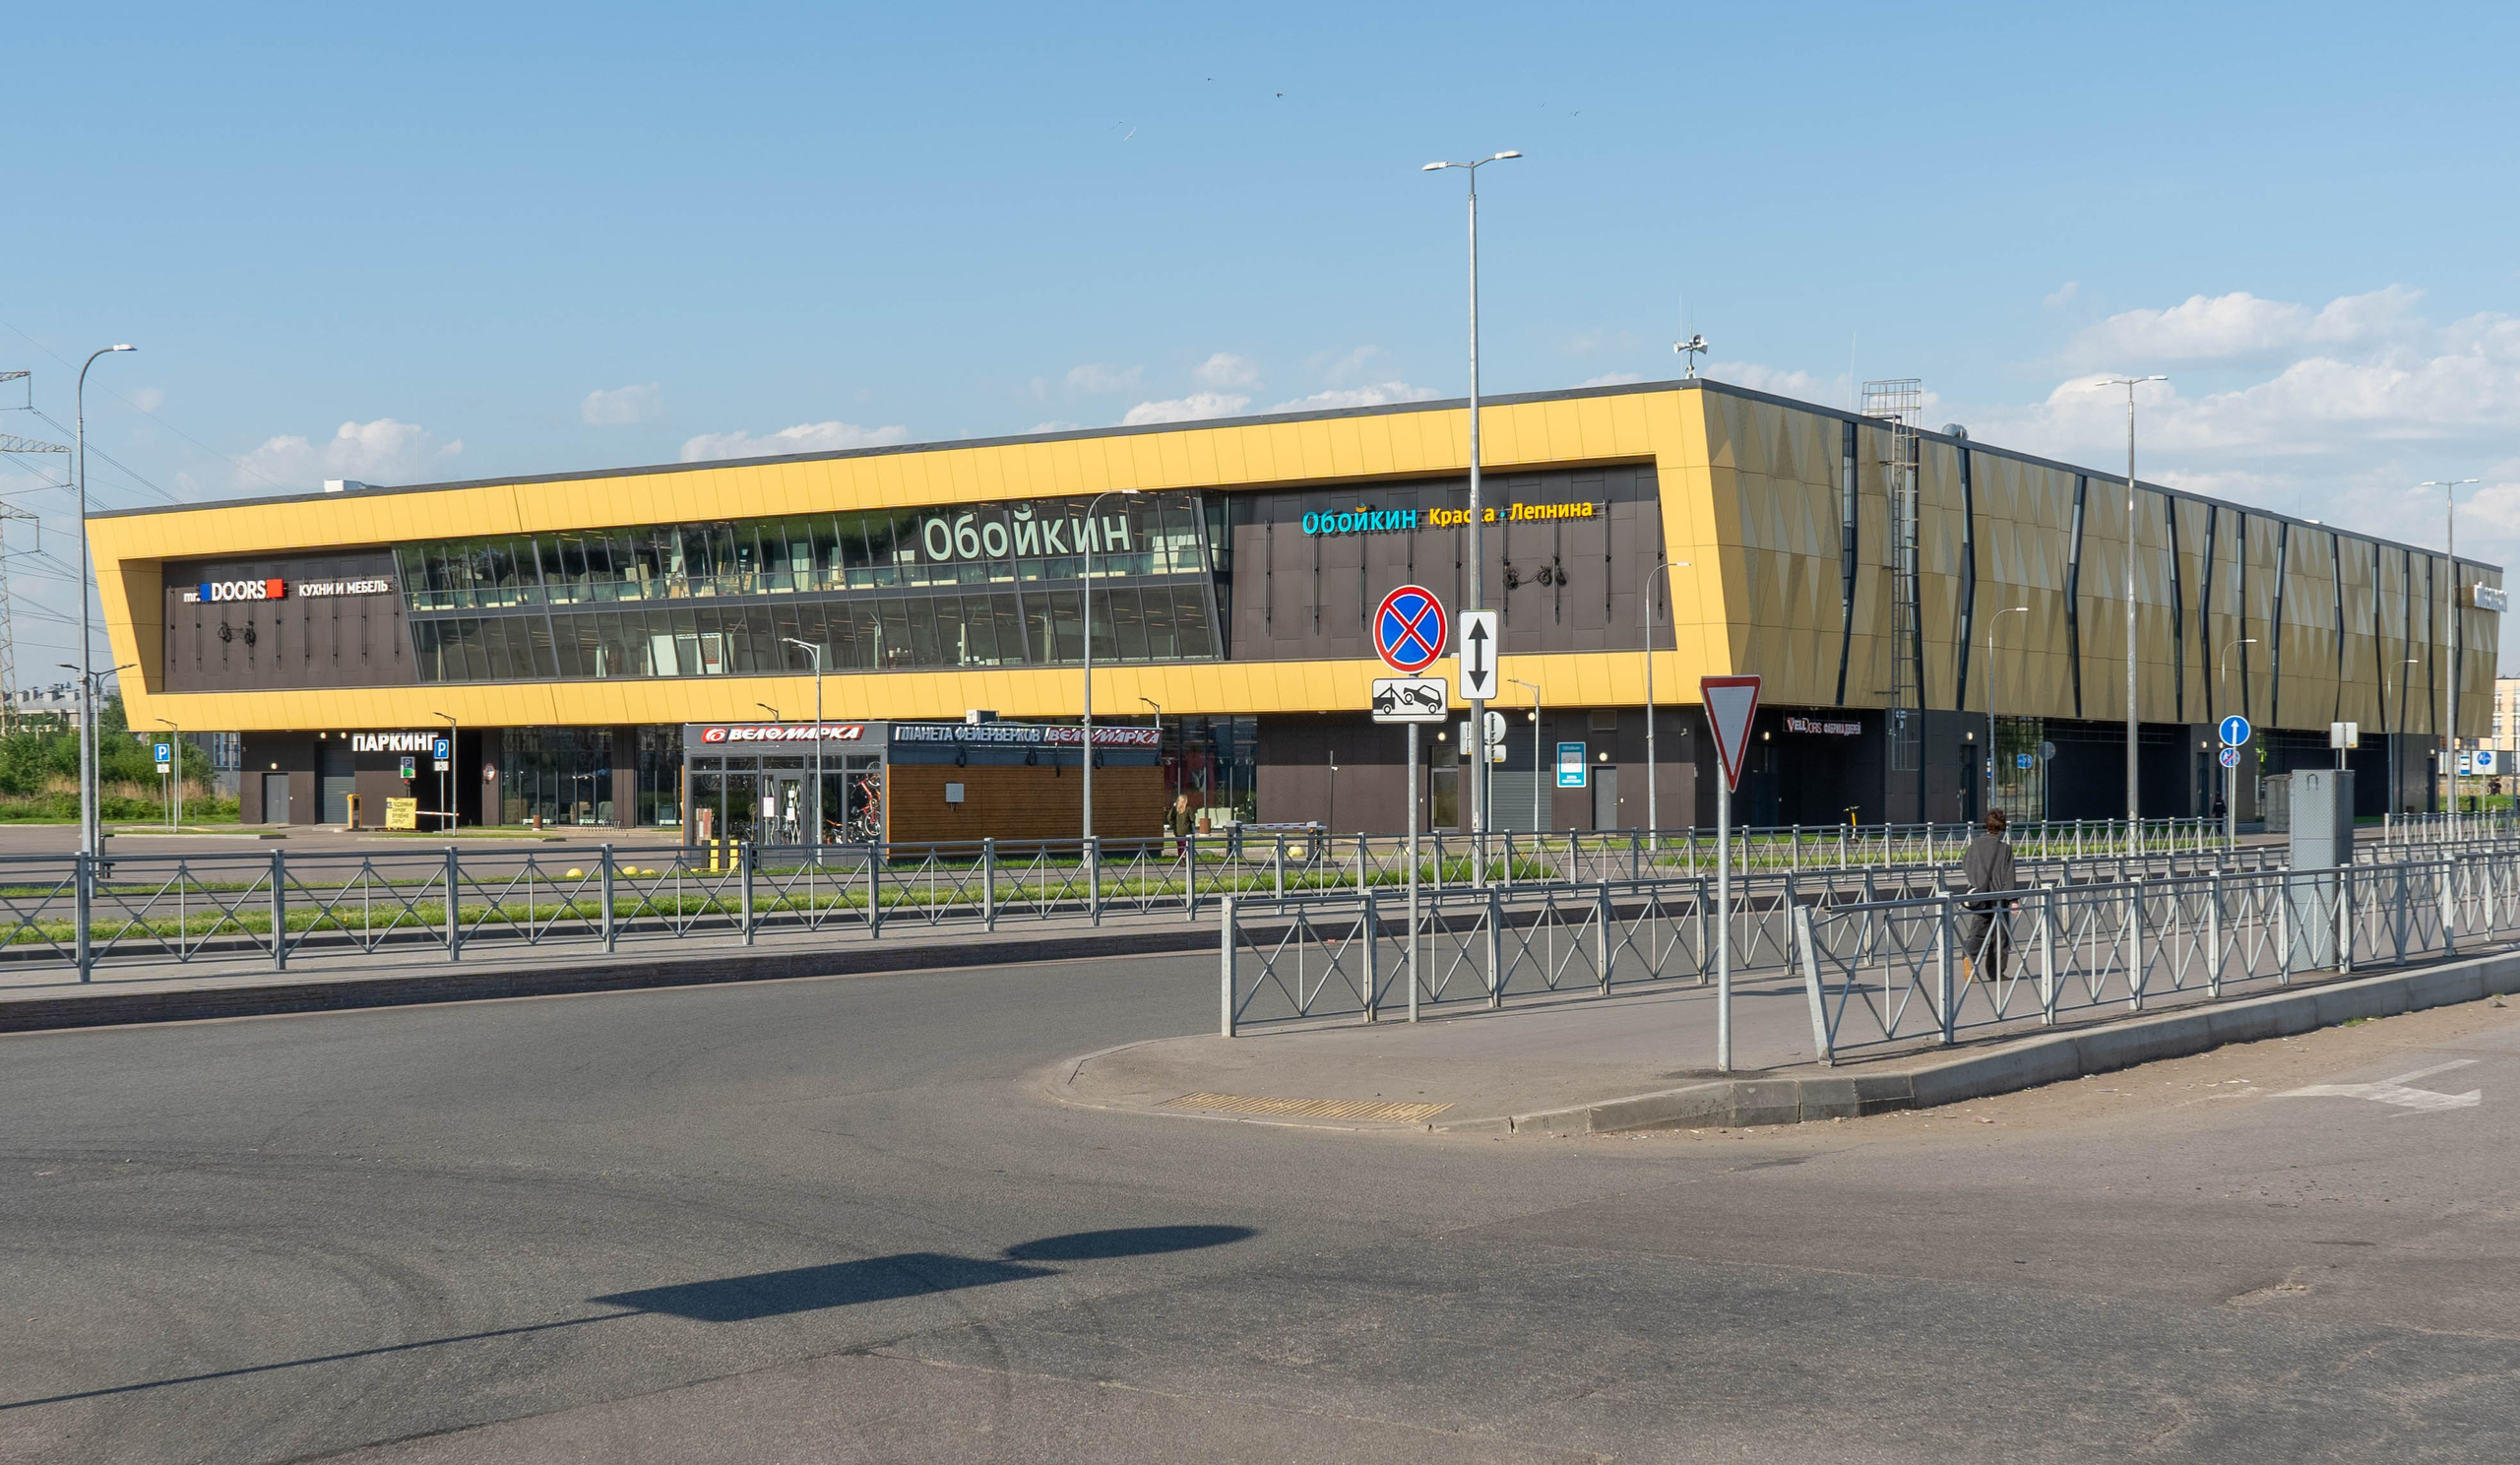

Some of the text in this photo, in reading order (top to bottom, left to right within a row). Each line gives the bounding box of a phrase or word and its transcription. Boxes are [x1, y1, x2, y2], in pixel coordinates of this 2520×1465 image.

[1302, 503, 1417, 535] Обойкин
[1429, 502, 1593, 527] Краса Лепнина
[924, 503, 1131, 561] Обойкин
[183, 580, 267, 603] mr. DOORS
[298, 579, 389, 597] КУХНИ И МЕБЕЛЬ
[352, 732, 438, 751] ПАРКИНГ
[728, 727, 861, 740] ВЕЛОМАРКА
[895, 727, 1040, 742] ПЛАНЕТА ФЕЙЕРВЕРКОВ
[1047, 729, 1161, 744] ВЕЛОМАРКА
[158, 746, 167, 759] P
[438, 742, 447, 756] P
